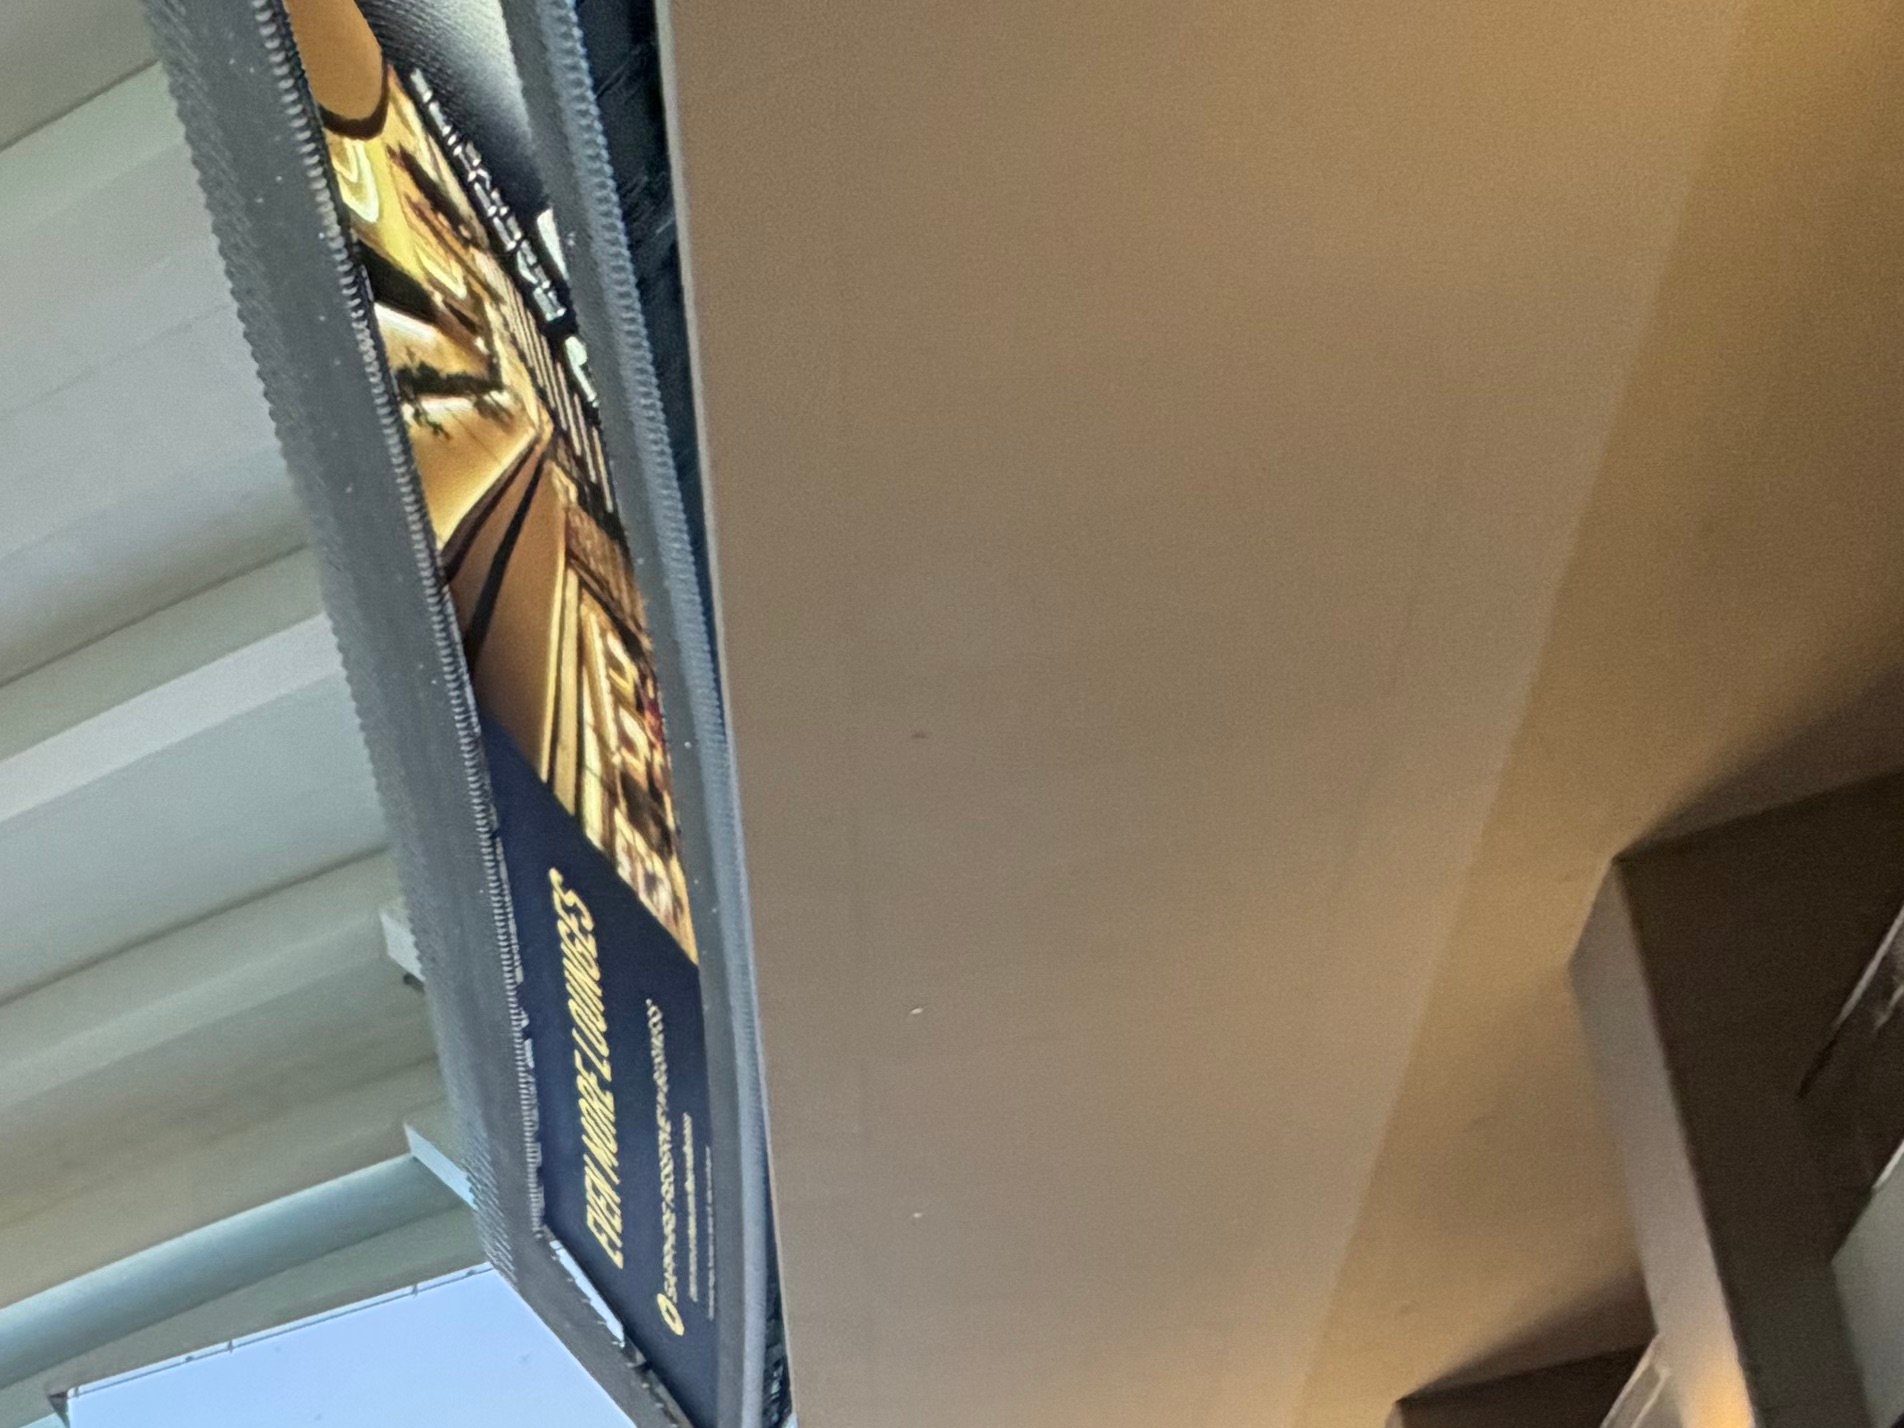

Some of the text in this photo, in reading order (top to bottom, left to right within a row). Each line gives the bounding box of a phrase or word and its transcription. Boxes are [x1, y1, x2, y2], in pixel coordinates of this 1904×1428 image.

[549, 867, 623, 1270] EVEN MORE LOUNGES
